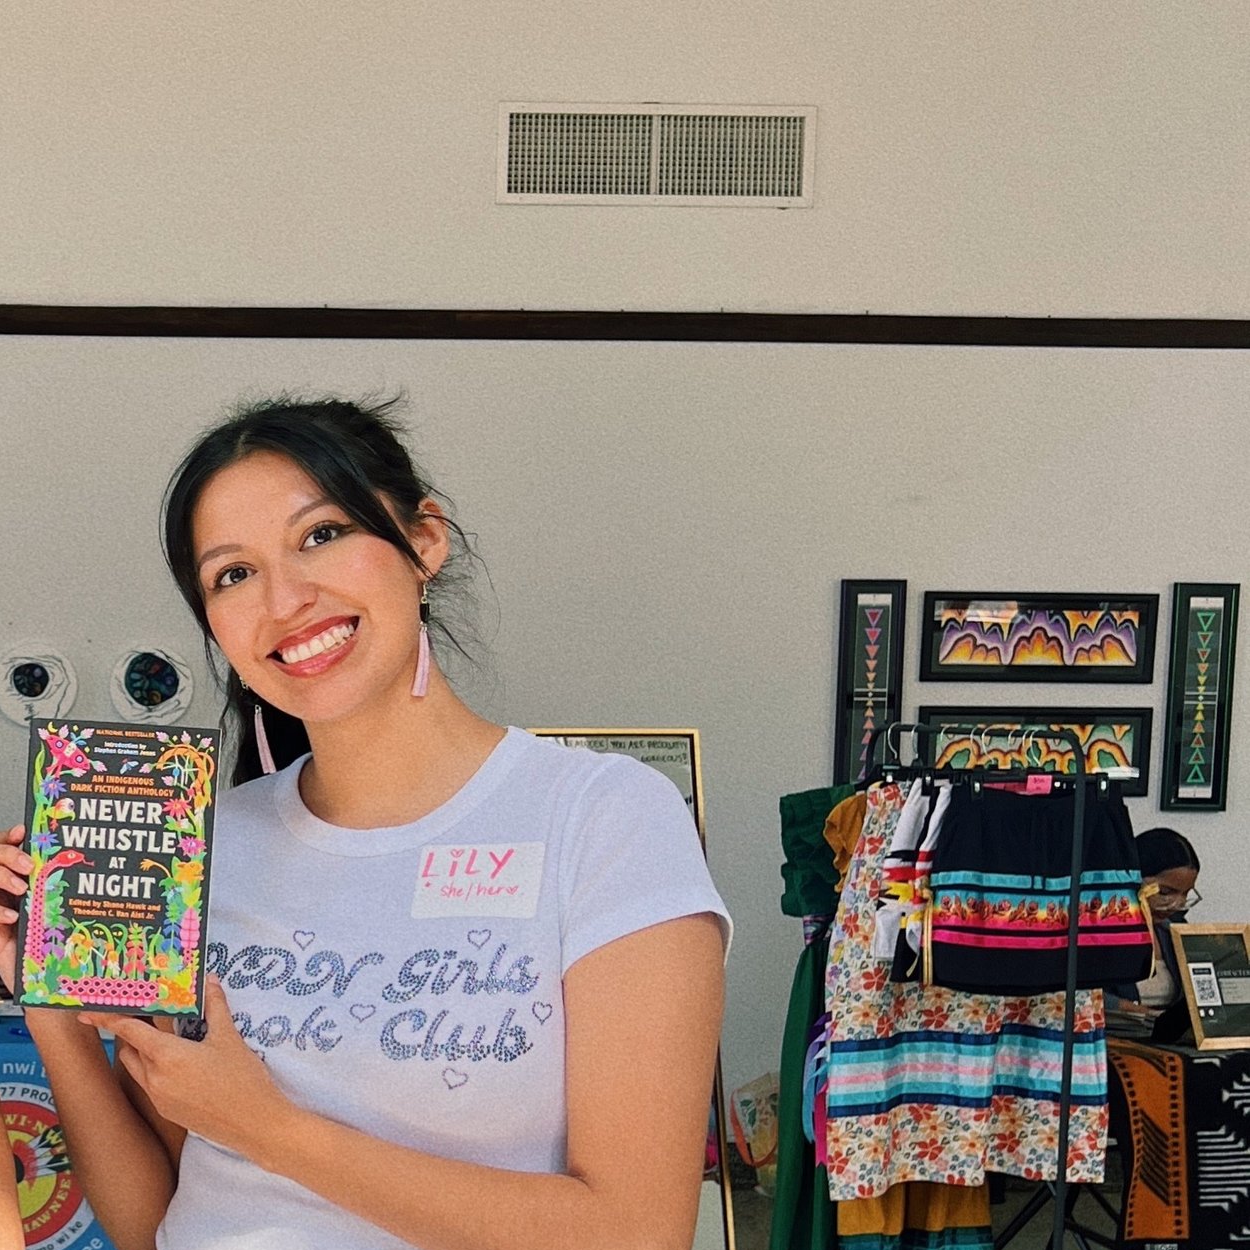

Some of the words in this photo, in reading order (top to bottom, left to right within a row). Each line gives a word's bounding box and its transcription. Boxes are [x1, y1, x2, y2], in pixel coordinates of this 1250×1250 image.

[92, 775, 105, 783] AN
[106, 775, 154, 786] INDIGENOUS
[70, 783, 93, 792] DARK
[94, 785, 126, 795] FICTION
[127, 787, 174, 797] ANTHOLOGY
[79, 798, 163, 824] NEVER
[61, 825, 177, 854] WHISTLE
[108, 856, 127, 869] AT
[77, 873, 156, 898] NIGHT
[68, 898, 91, 907] Edited
[92, 900, 102, 908] by
[102, 901, 125, 909] Shane
[73, 907, 107, 916] Theodore
[232, 1006, 342, 1052] ook
[380, 1008, 533, 1062] Club
